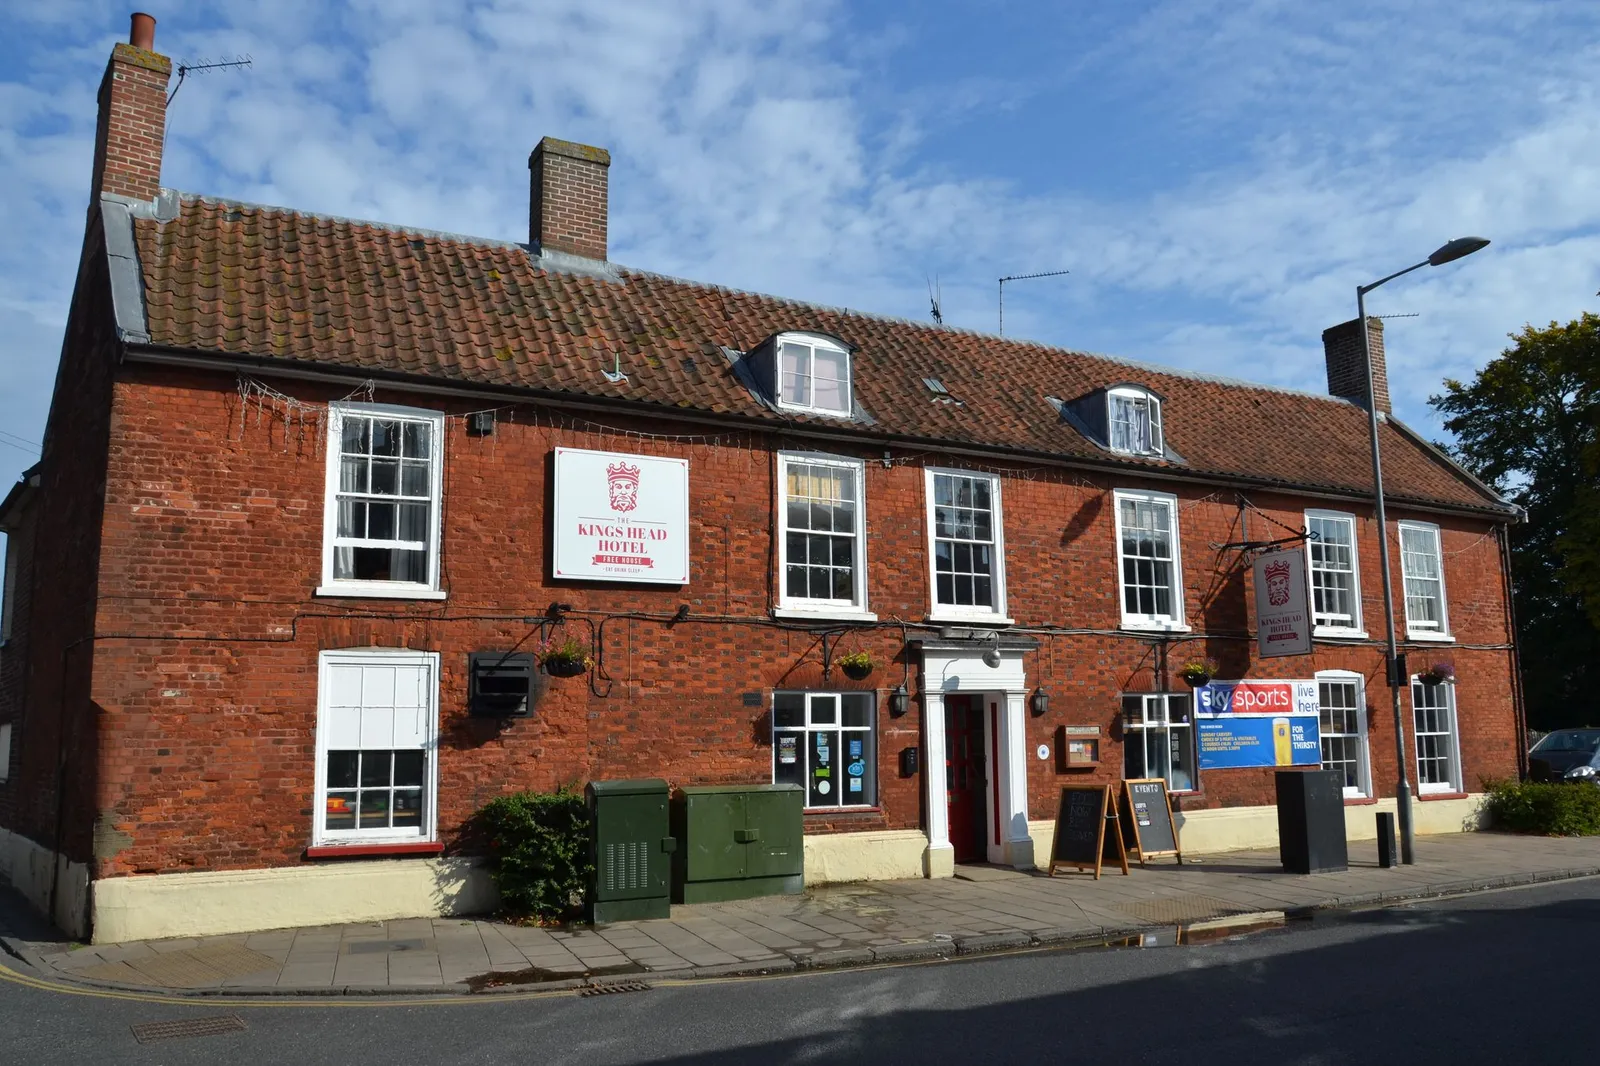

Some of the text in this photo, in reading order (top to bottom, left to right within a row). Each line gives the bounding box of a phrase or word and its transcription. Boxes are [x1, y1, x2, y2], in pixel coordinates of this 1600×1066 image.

[578, 524, 668, 540] KINGS HEAD
[598, 540, 648, 554] HOTEL
[621, 556, 642, 564] HOUSE
[1271, 624, 1293, 633] HOTEL
[1298, 684, 1314, 698] live
[1201, 688, 1289, 711] sky sports
[1298, 700, 1319, 712] here
[1292, 726, 1304, 734] FOR
[1134, 784, 1159, 793] EVENTS
